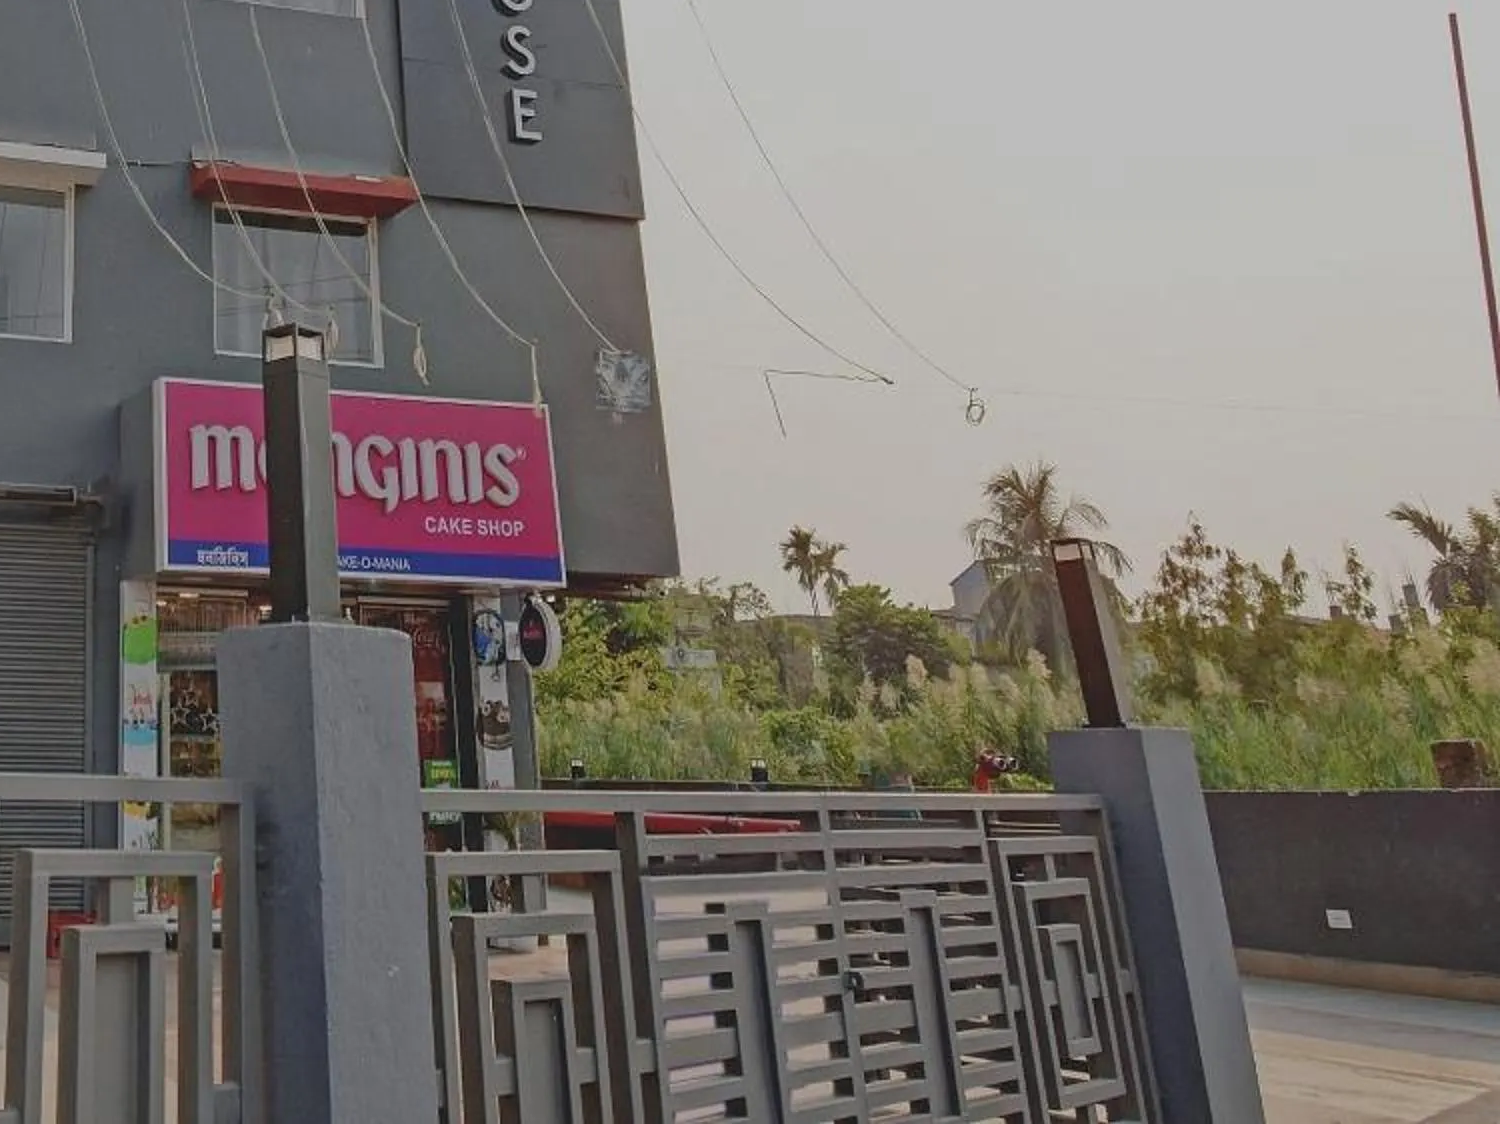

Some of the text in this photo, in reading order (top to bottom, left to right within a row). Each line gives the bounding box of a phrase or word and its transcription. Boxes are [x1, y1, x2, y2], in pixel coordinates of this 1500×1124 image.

[189, 424, 521, 515] mnginis
[424, 516, 525, 537] CAKE SHOP
